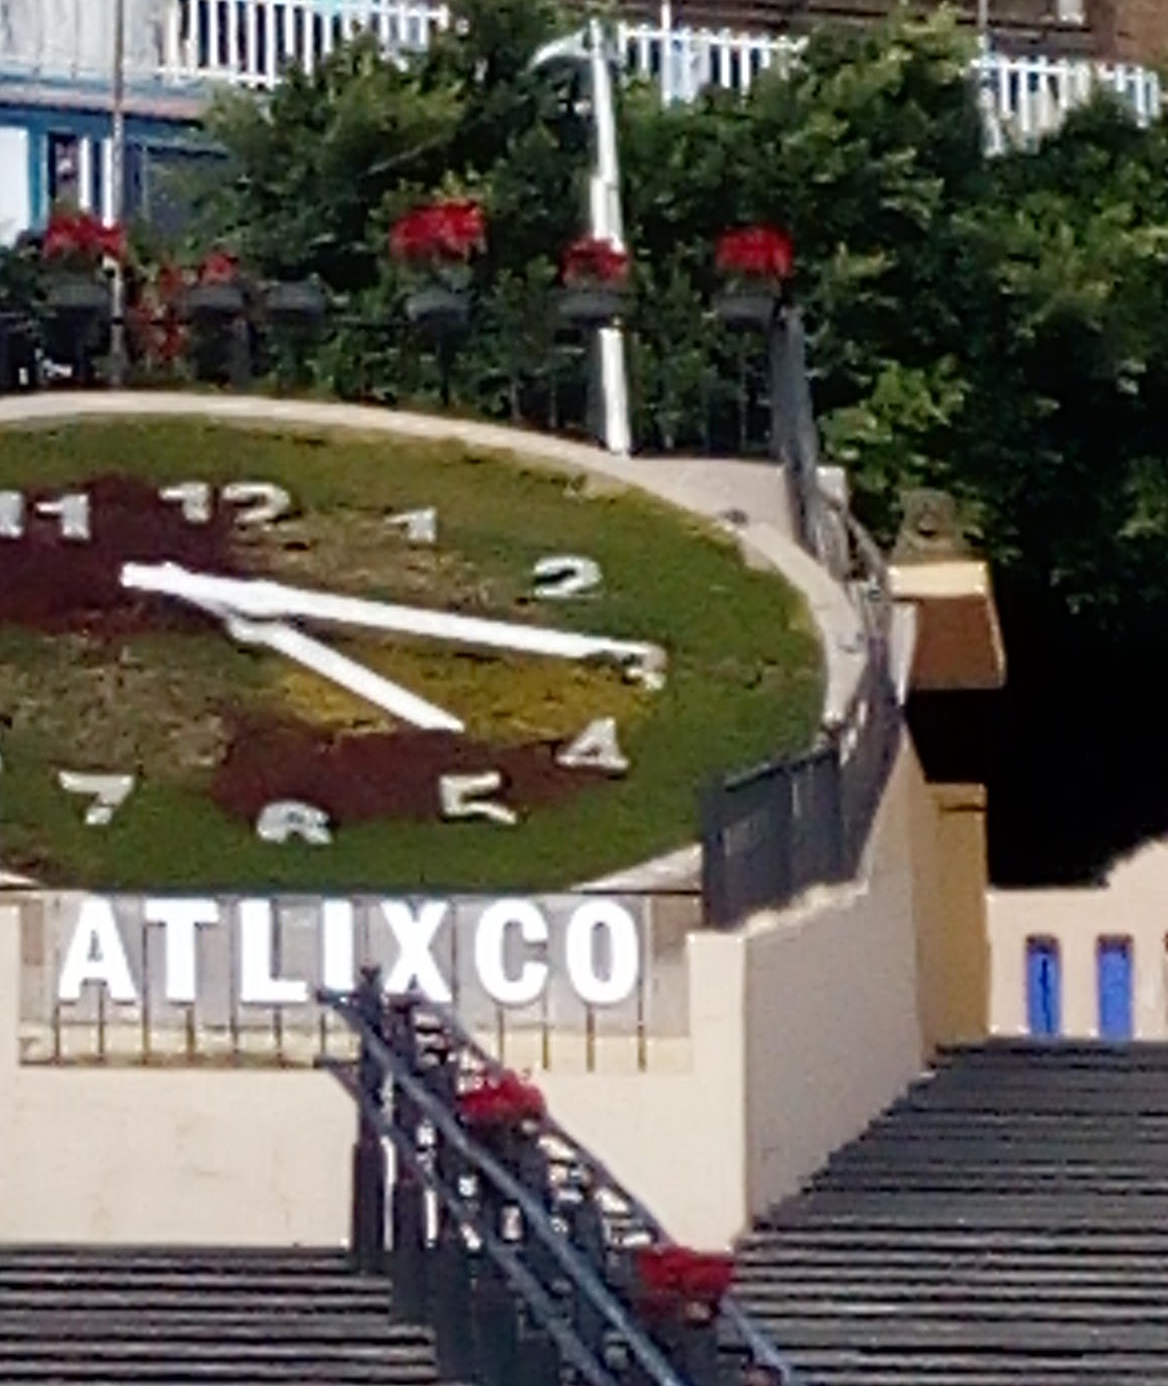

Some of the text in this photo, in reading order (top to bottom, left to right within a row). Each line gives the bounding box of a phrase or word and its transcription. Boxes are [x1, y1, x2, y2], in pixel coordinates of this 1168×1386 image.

[158, 480, 291, 525] 12
[386, 505, 437, 543] 1
[532, 554, 604, 599] 2
[555, 716, 630, 771] 4
[57, 770, 134, 826] 7
[438, 770, 519, 826] 5
[57, 898, 640, 1004] ATLIXCO
